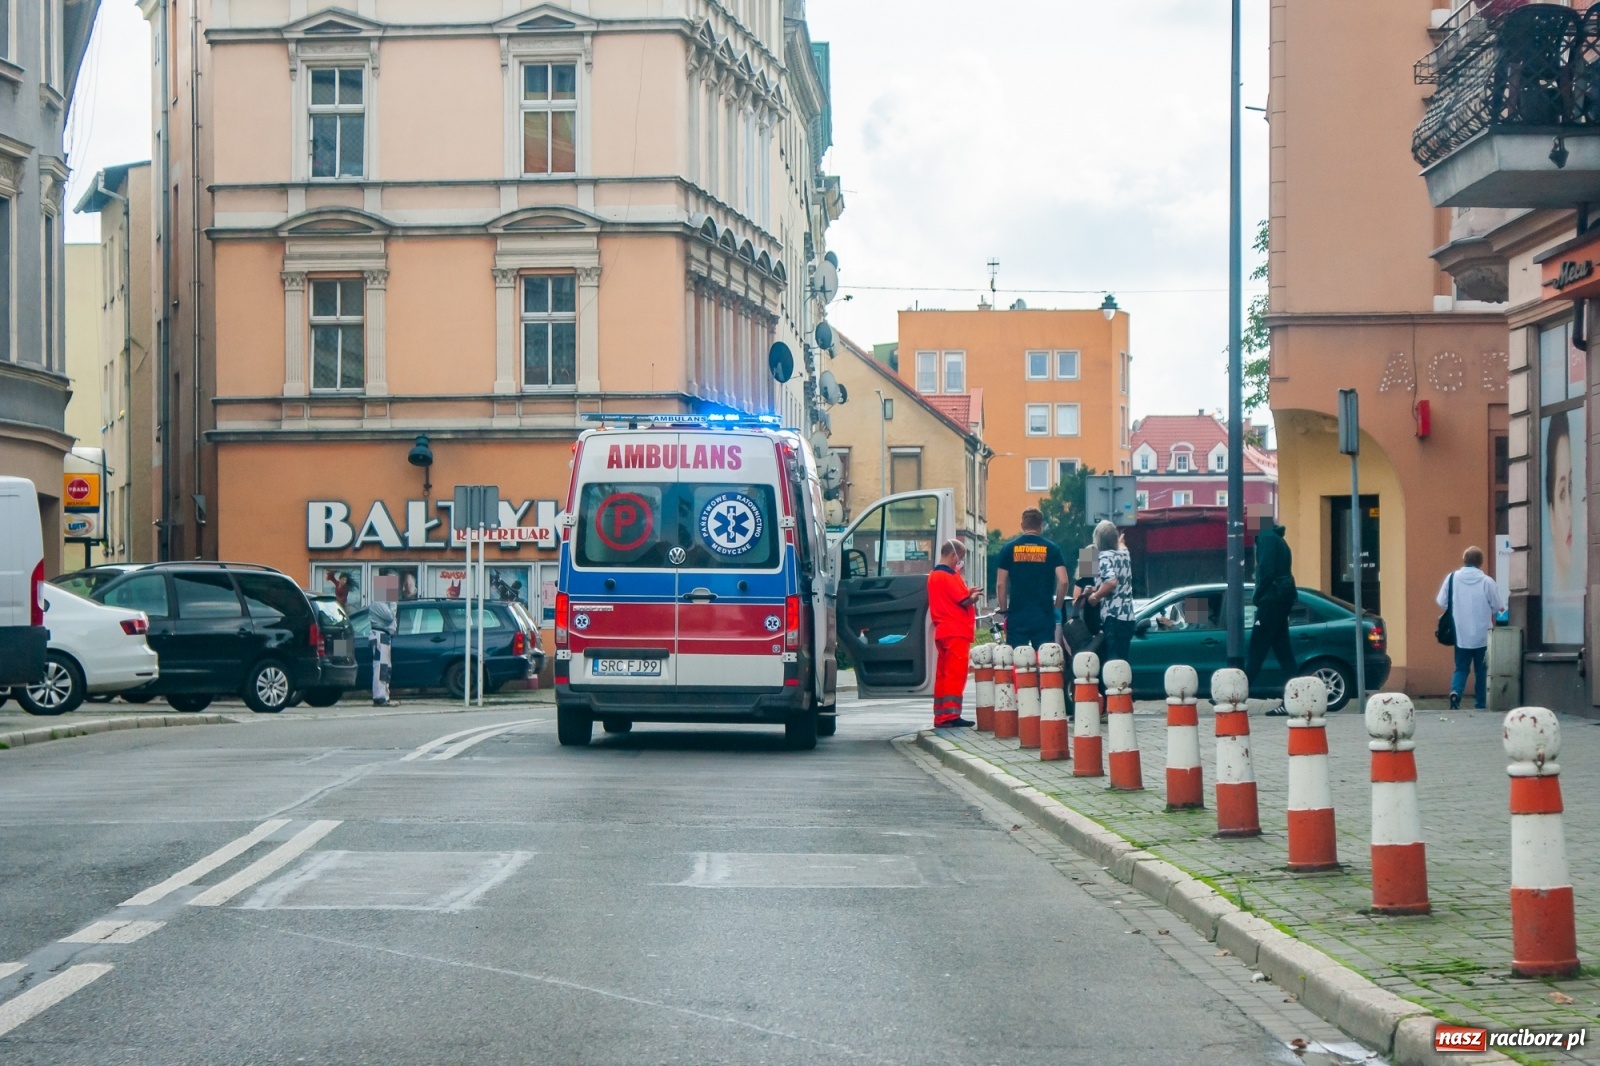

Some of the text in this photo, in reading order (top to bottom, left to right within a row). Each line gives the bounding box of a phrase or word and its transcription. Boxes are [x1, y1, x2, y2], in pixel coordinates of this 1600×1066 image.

[607, 444, 742, 471] AMBULANS
[614, 505, 637, 538] P
[700, 494, 763, 555] PAŃSTWOWE RATOWNICTWO MEDYCZNE
[601, 660, 623, 672] SRC
[627, 660, 657, 672] FJ99
